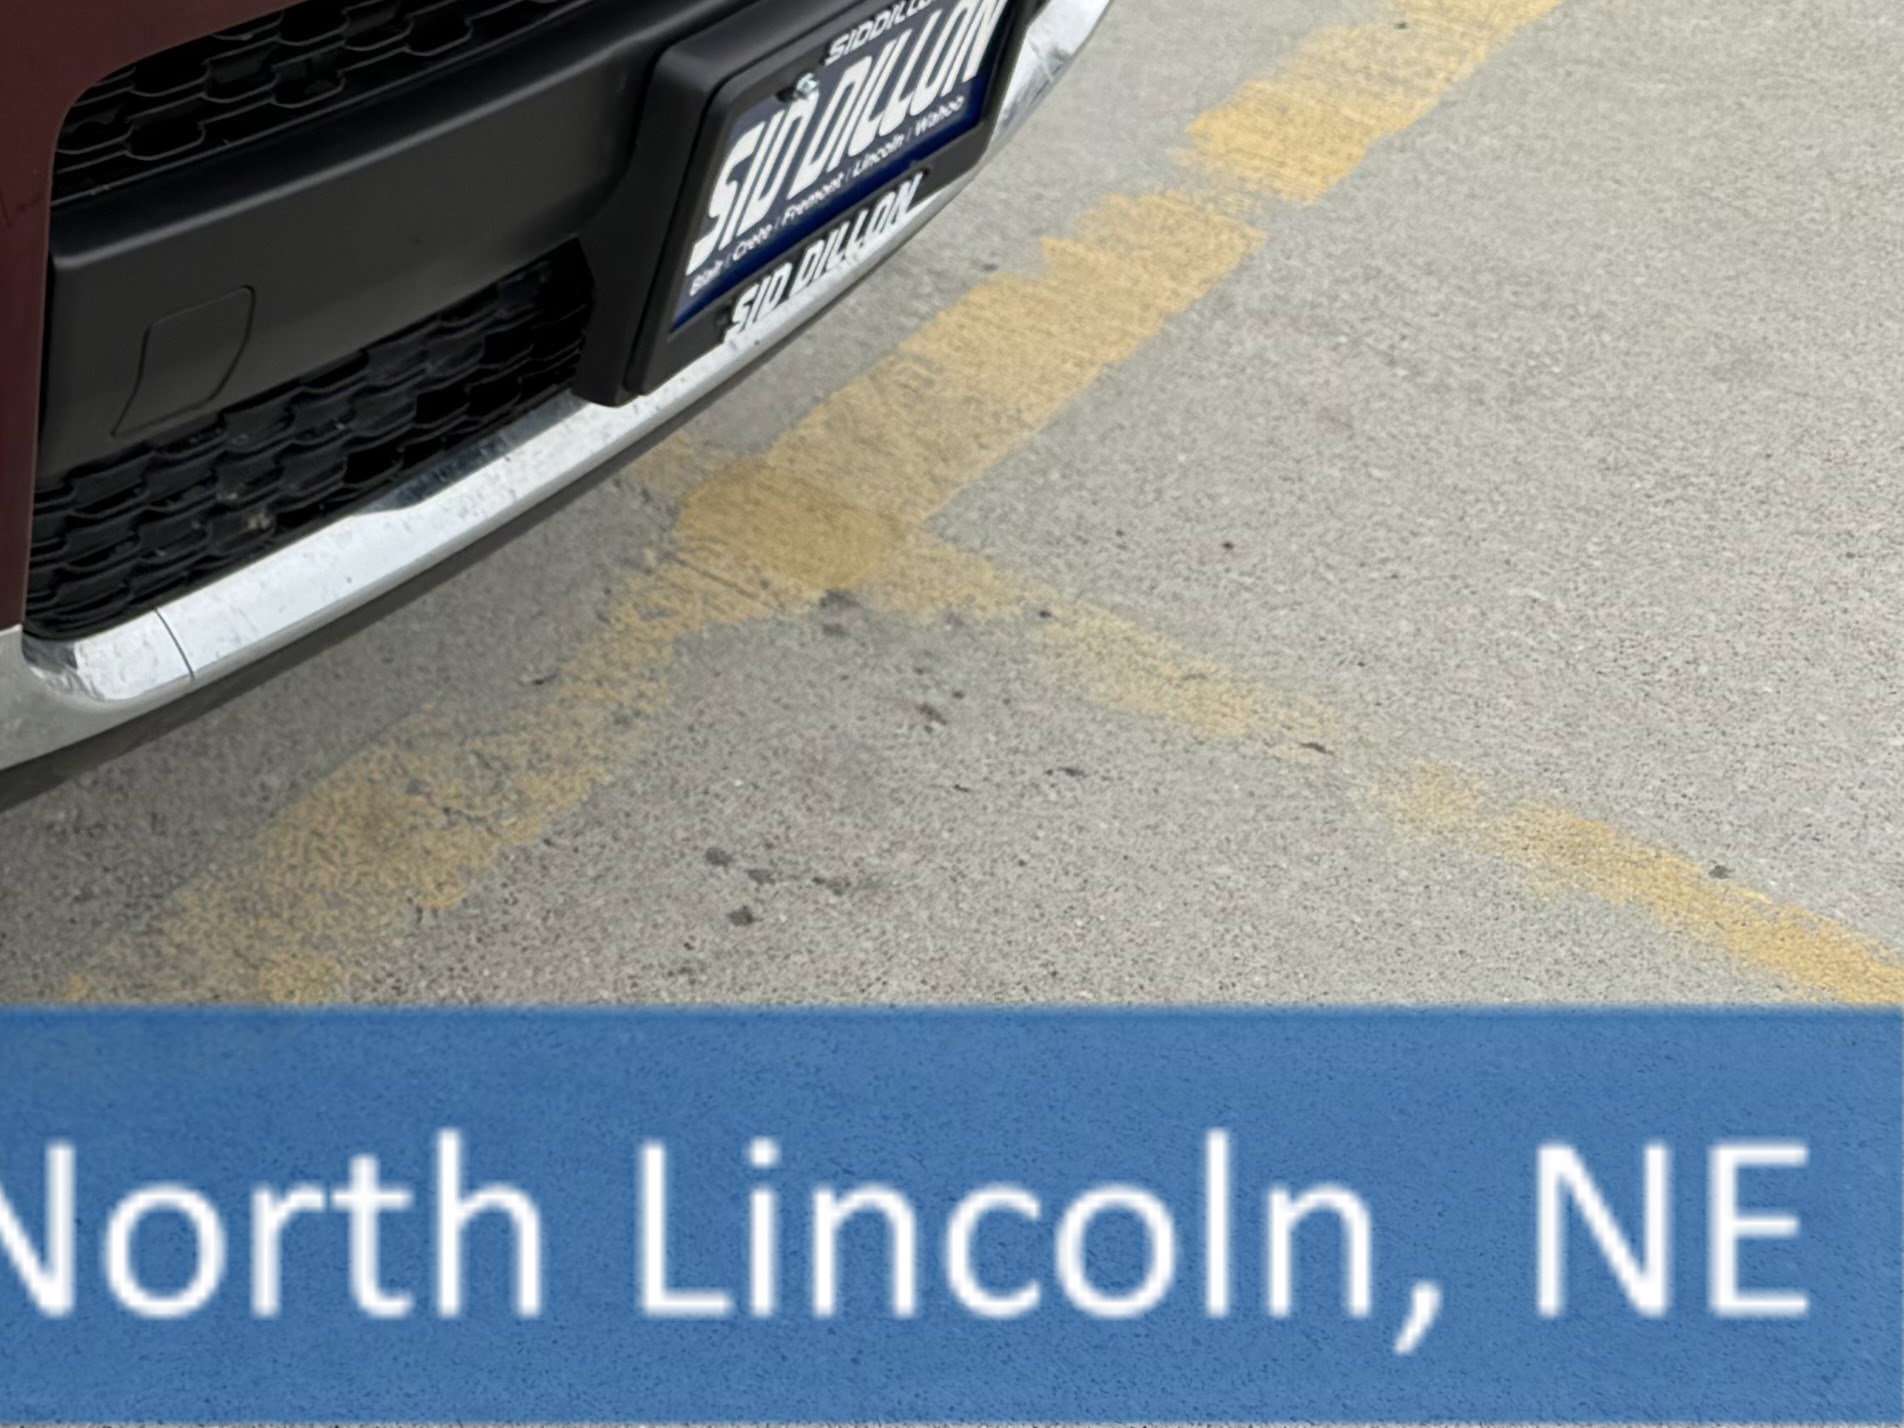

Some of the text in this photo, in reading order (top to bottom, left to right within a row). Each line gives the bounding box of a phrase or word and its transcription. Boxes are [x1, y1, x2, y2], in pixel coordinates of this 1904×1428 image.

[685, 89, 820, 277] SID
[723, 171, 924, 344] SID DILLON
